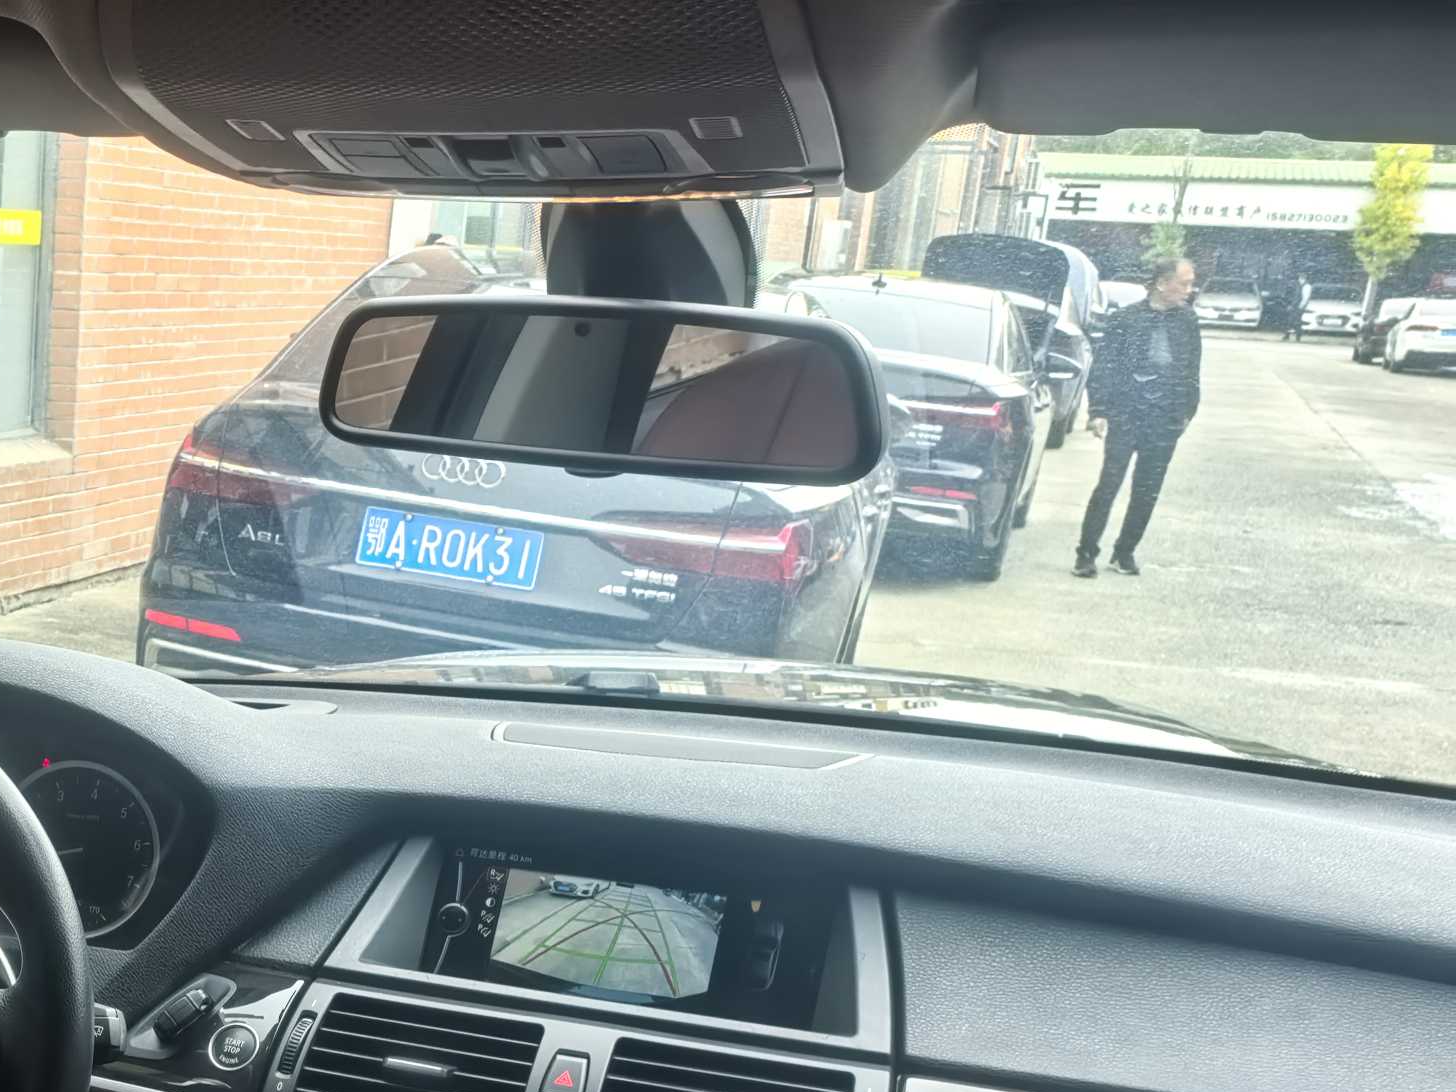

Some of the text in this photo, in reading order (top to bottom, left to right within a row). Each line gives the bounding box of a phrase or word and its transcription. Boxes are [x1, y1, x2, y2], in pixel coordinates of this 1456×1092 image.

[1054, 182, 1102, 216] 车
[224, 1037, 244, 1047] START
[224, 1046, 241, 1054] STOP
